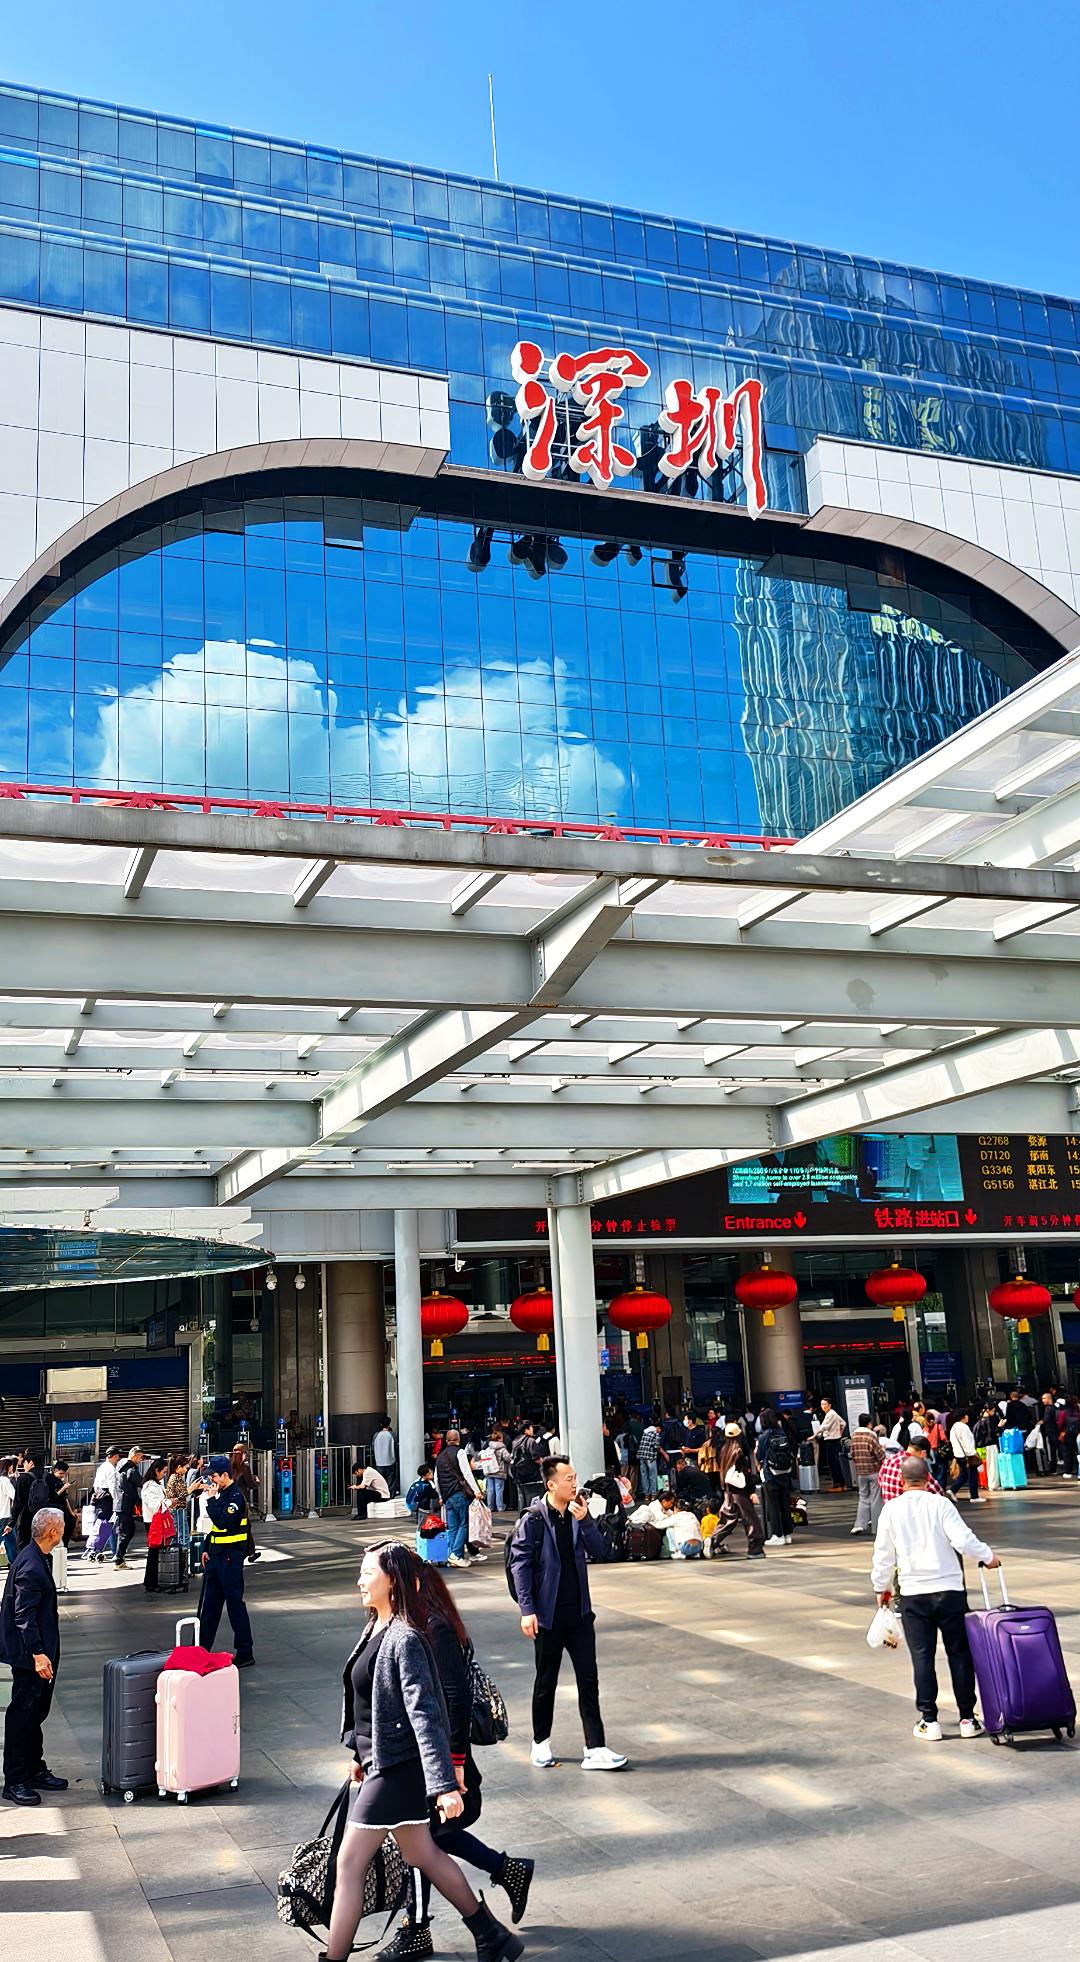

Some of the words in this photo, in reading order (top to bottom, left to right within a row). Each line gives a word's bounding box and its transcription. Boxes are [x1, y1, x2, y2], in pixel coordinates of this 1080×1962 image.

[511, 341, 767, 520] 深圳
[978, 1135, 1009, 1146] G2768
[980, 1150, 1010, 1161] D7120
[981, 1165, 1013, 1175] G3346
[983, 1180, 1015, 1190] G5156
[724, 1215, 792, 1230] Entrance
[874, 1207, 960, 1229] 铁路进站口
